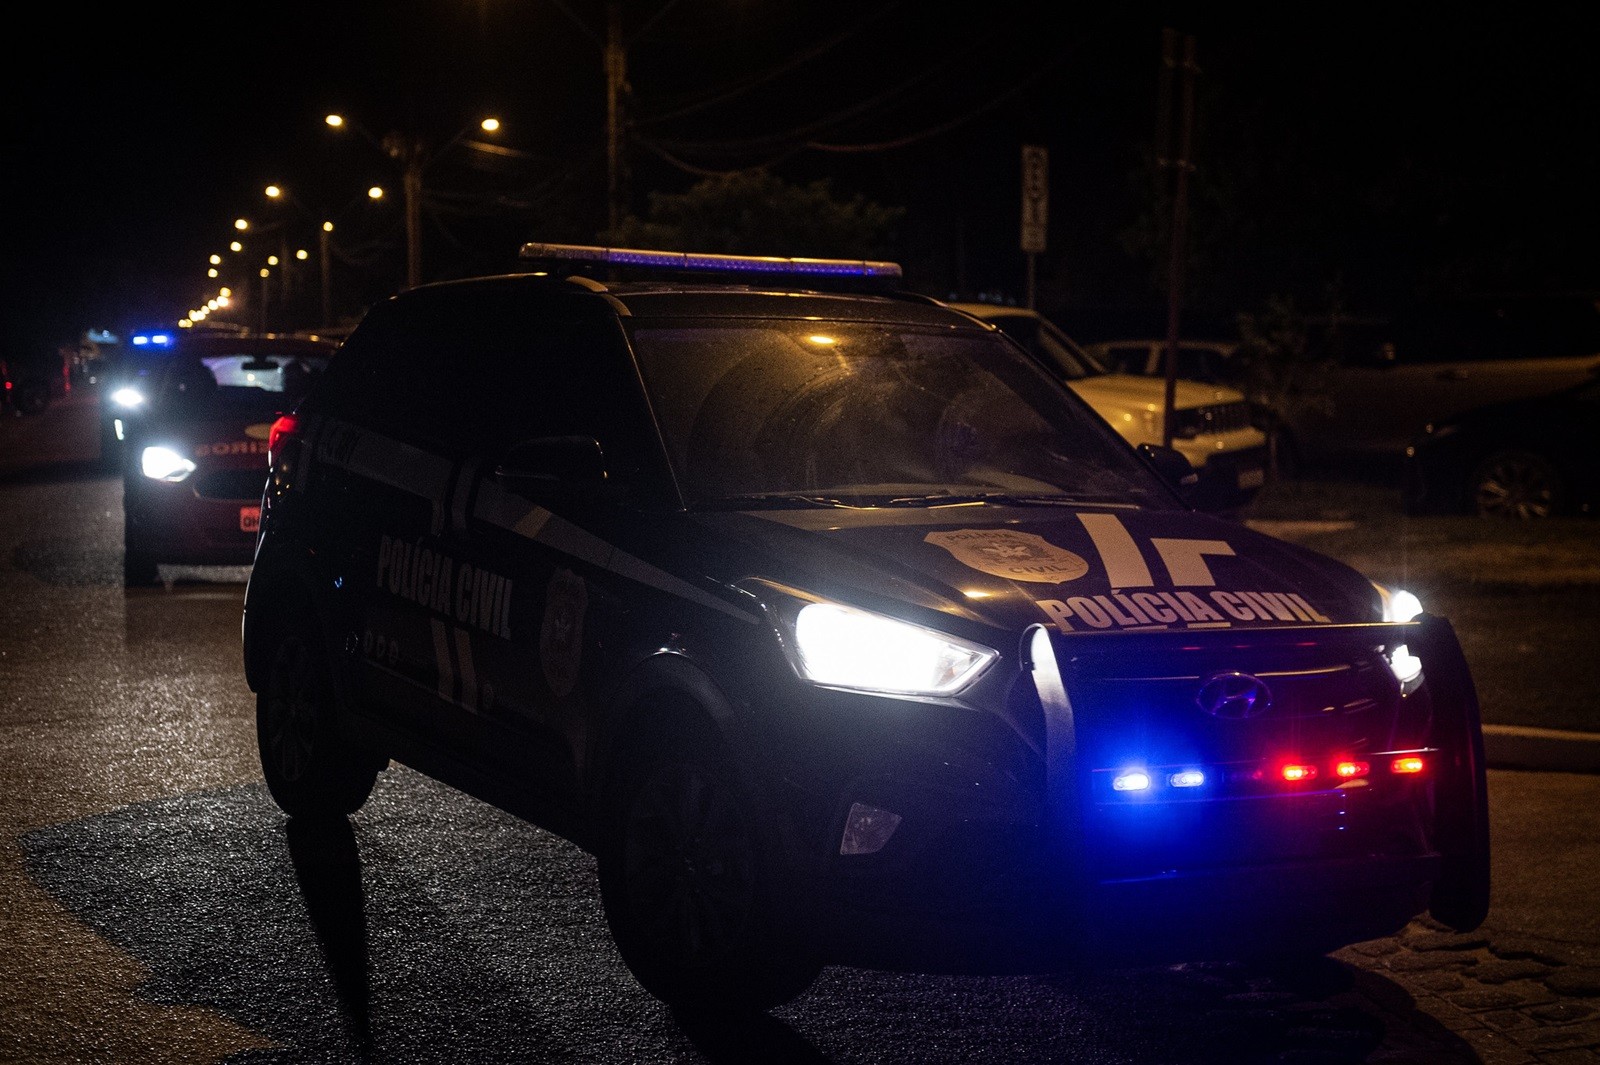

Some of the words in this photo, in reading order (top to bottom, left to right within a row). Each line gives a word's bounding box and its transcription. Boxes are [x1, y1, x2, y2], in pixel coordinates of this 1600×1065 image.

[377, 534, 453, 617] POLÍCIA
[456, 562, 513, 641] CIVIL
[1008, 564, 1067, 575] CIVIL
[1035, 589, 1225, 632] POLÍCIA
[1210, 591, 1332, 623] CIVIL
